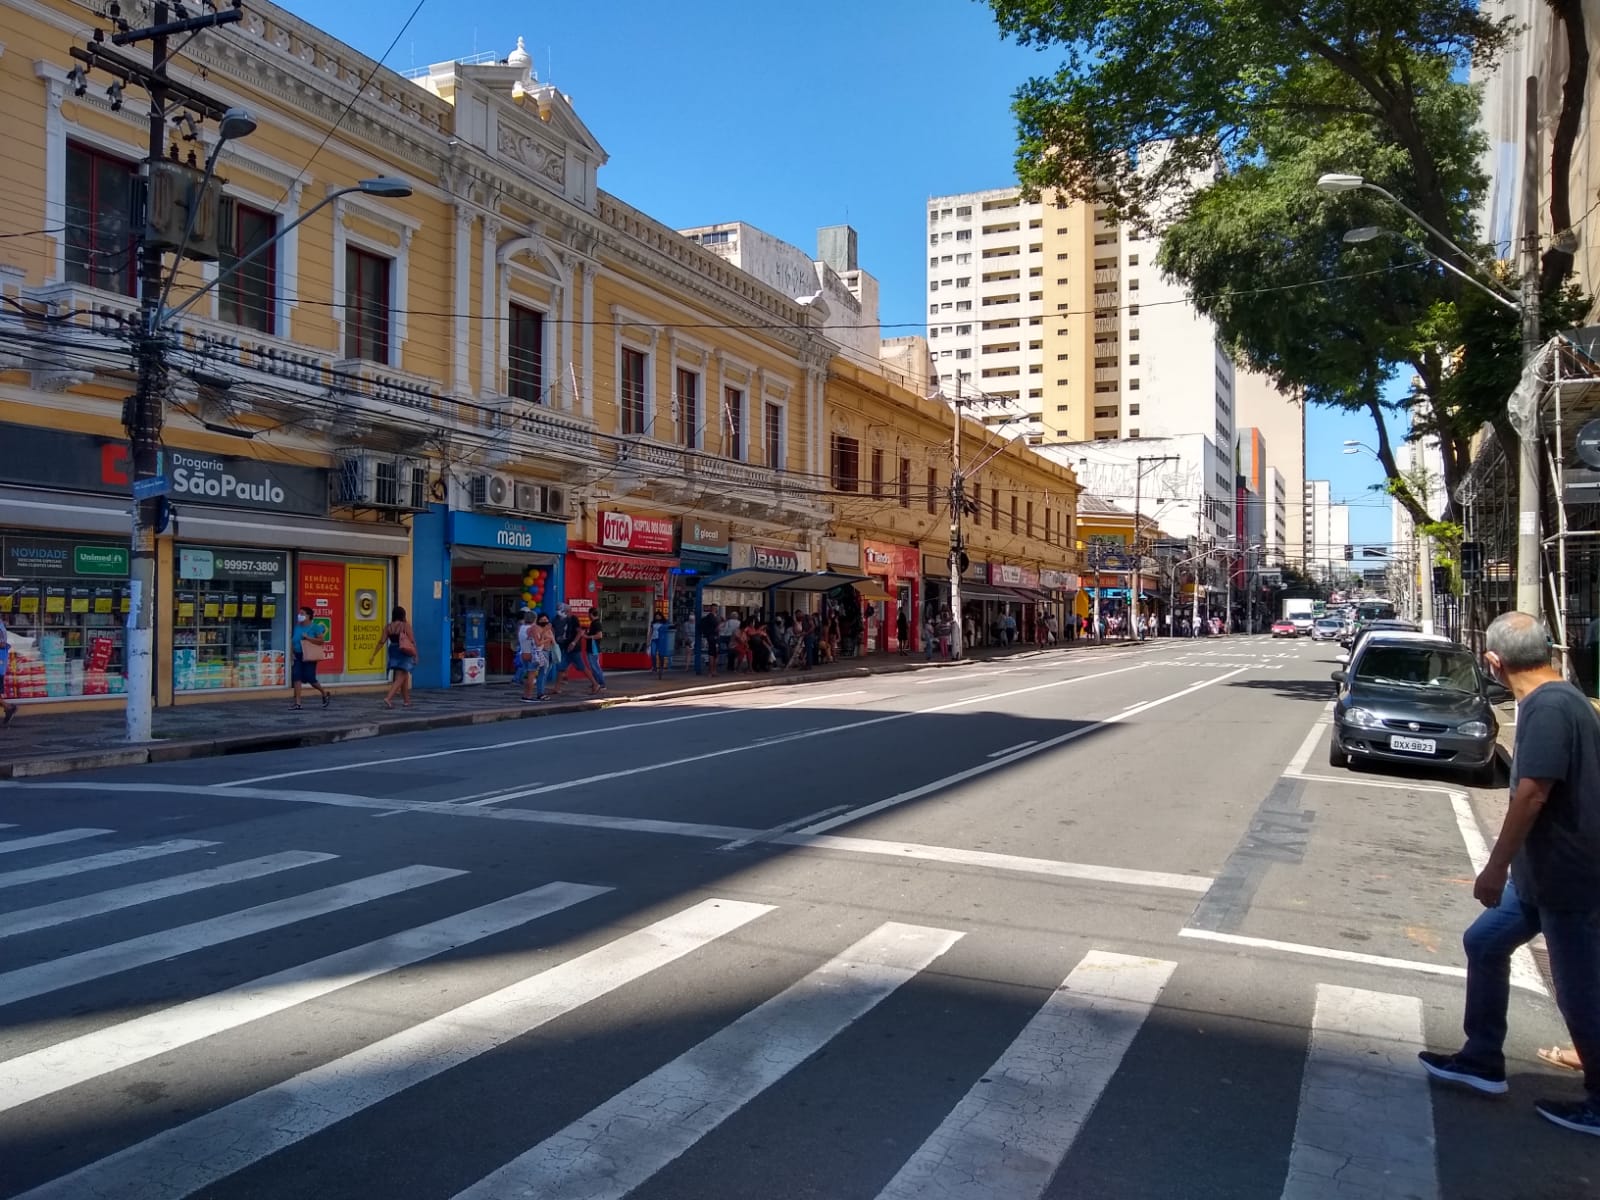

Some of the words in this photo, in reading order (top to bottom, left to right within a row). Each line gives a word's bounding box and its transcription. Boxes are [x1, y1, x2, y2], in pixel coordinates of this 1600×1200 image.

[173, 454, 224, 471] Drogaria
[173, 468, 285, 503] SãoPaulo
[604, 514, 630, 541] ÓTICA
[633, 519, 651, 533] HOSPITAL
[497, 530, 532, 547] mania
[11, 547, 70, 559] NOVIDADE
[80, 553, 112, 562] Unimed
[224, 559, 279, 572] 99957-3800
[756, 553, 797, 571] BAHIA
[304, 575, 340, 583] REMÉDIOS
[362, 598, 371, 610] G
[353, 624, 380, 632] REMÉDIO
